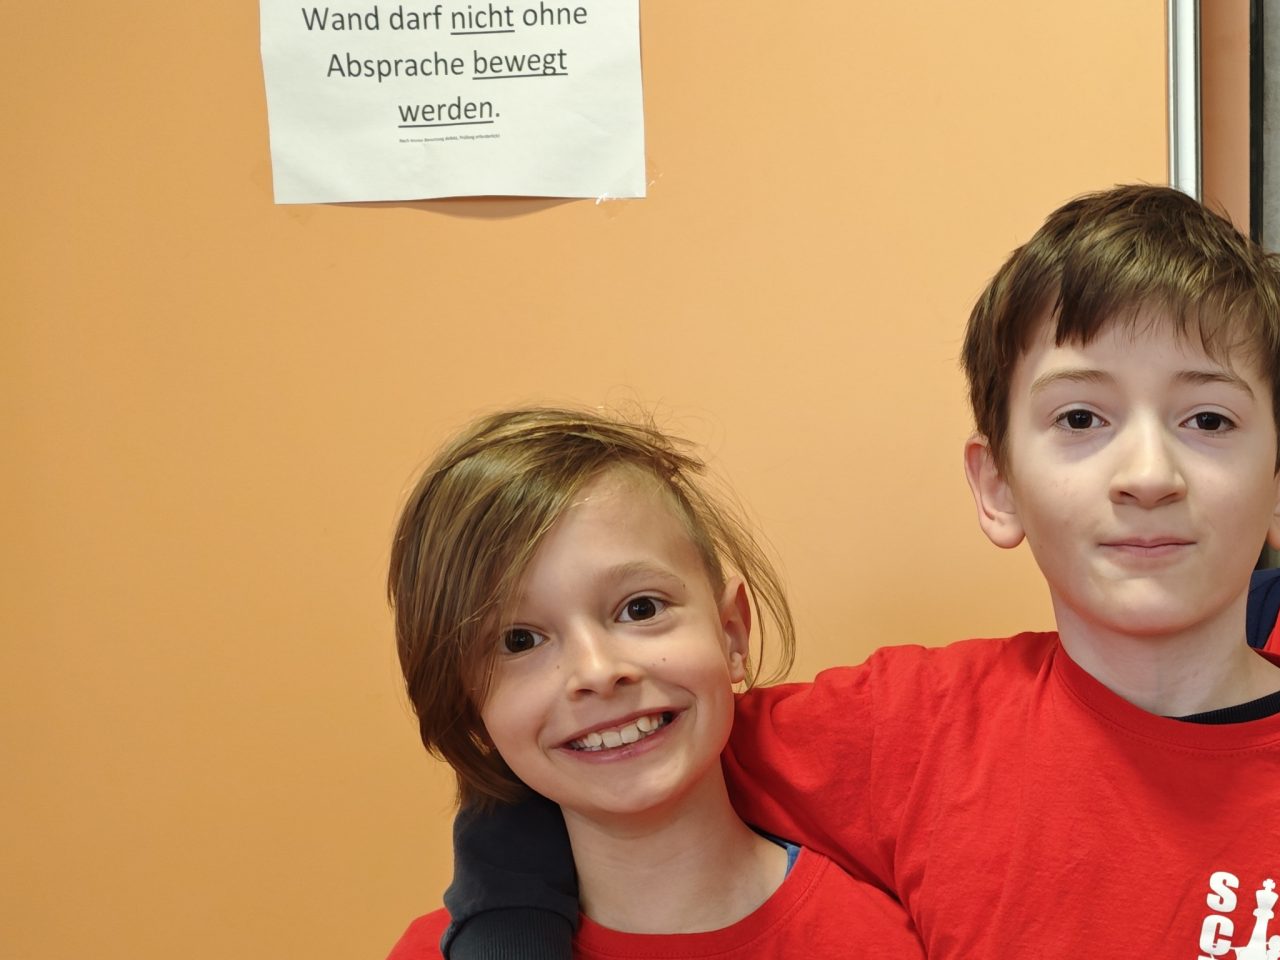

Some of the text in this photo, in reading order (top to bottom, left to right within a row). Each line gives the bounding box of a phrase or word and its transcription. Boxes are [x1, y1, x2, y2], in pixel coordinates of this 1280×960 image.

[302, 2, 588, 31] Wand darf nicht ohne
[327, 49, 568, 82] Absprache bewegt
[398, 97, 500, 123] werden.
